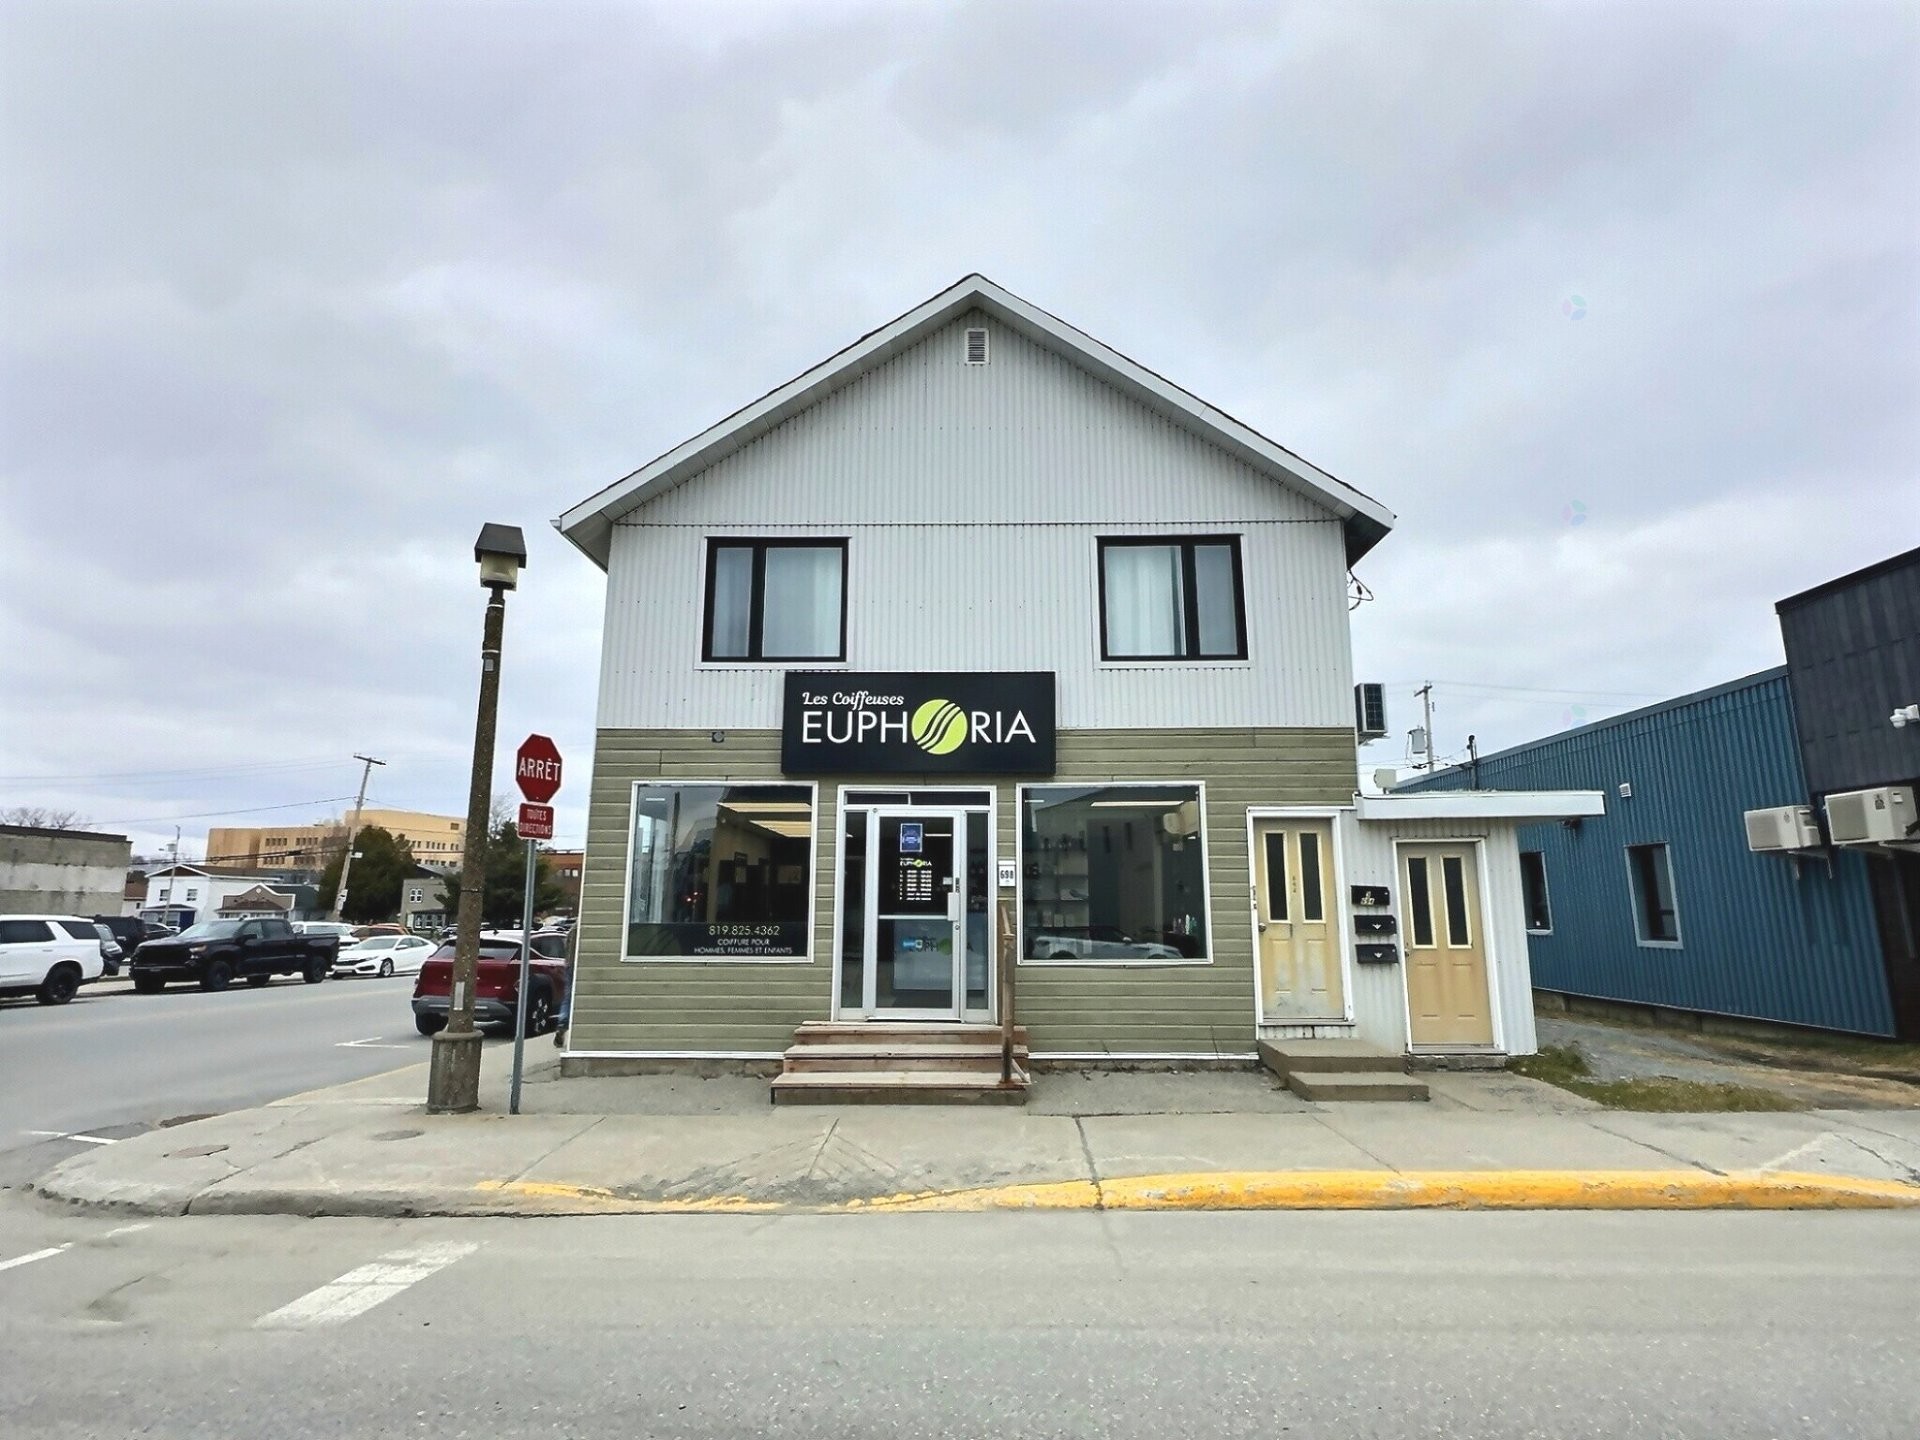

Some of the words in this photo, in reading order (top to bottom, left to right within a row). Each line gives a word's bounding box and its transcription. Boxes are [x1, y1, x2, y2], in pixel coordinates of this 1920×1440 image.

[802, 692, 828, 706] Les
[832, 691, 905, 711] Coiffeuses
[518, 757, 561, 782] ARRÊT
[708, 925, 781, 936] 819.825.4362
[717, 938, 750, 946] COIFFURE
[751, 938, 770, 946] POUR
[764, 946, 793, 955] ENFANTS
